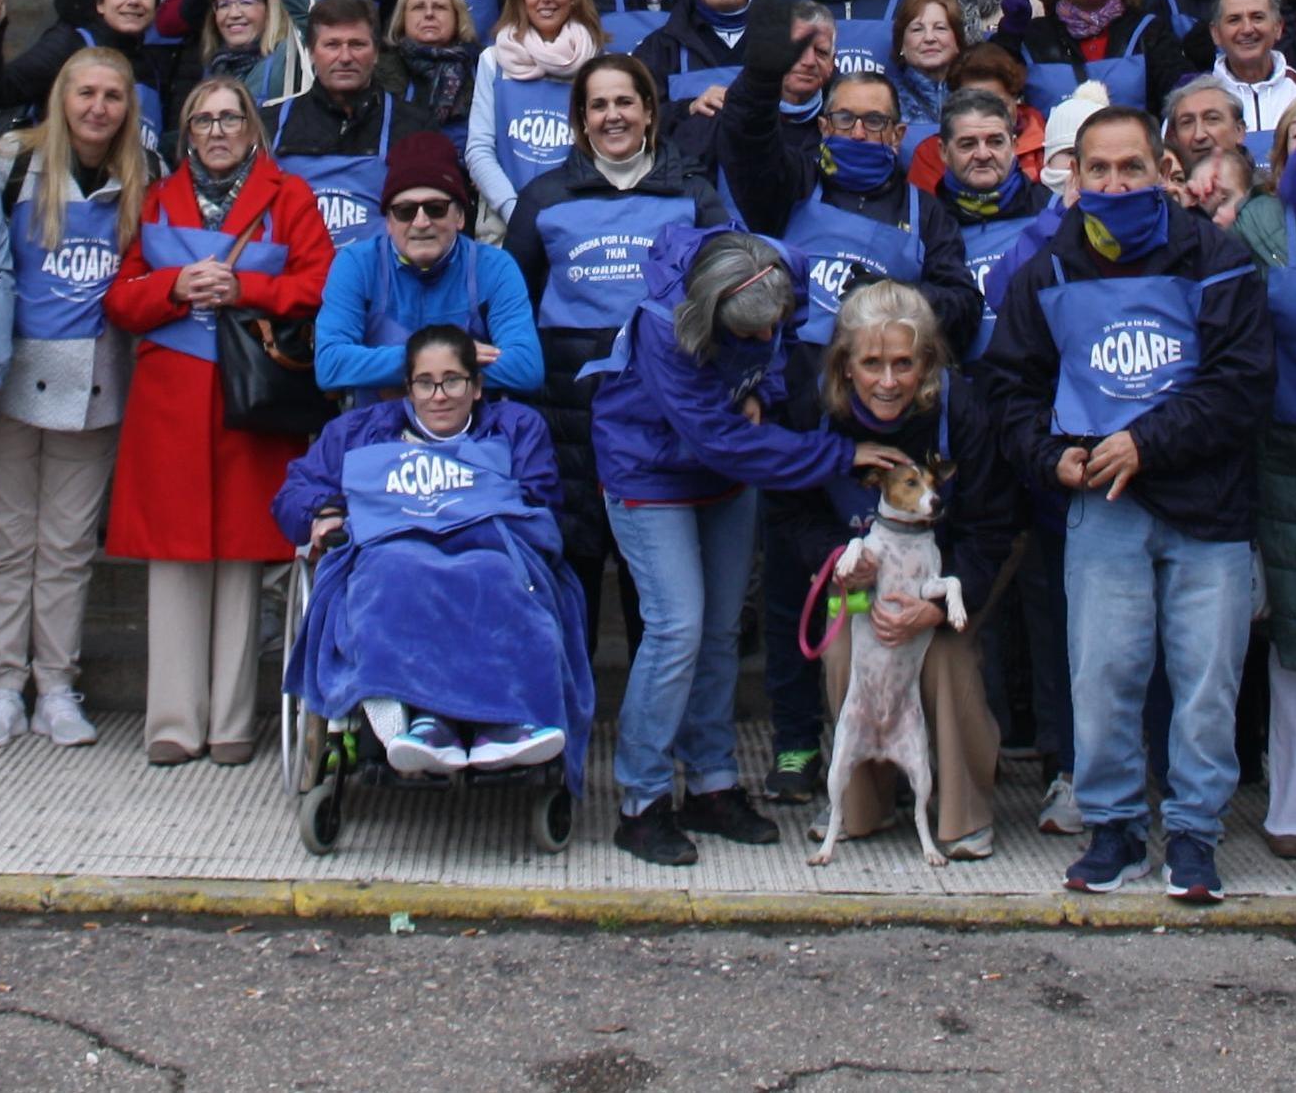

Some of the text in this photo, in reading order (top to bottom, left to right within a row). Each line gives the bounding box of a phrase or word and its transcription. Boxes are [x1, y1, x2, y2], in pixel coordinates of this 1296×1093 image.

[568, 237, 601, 260] MARCHA
[601, 235, 618, 245] POR
[619, 235, 630, 244] LA
[605, 247, 628, 260] 7KM
[1089, 330, 1182, 375] ACOARE
[385, 455, 475, 496] ACOARE
